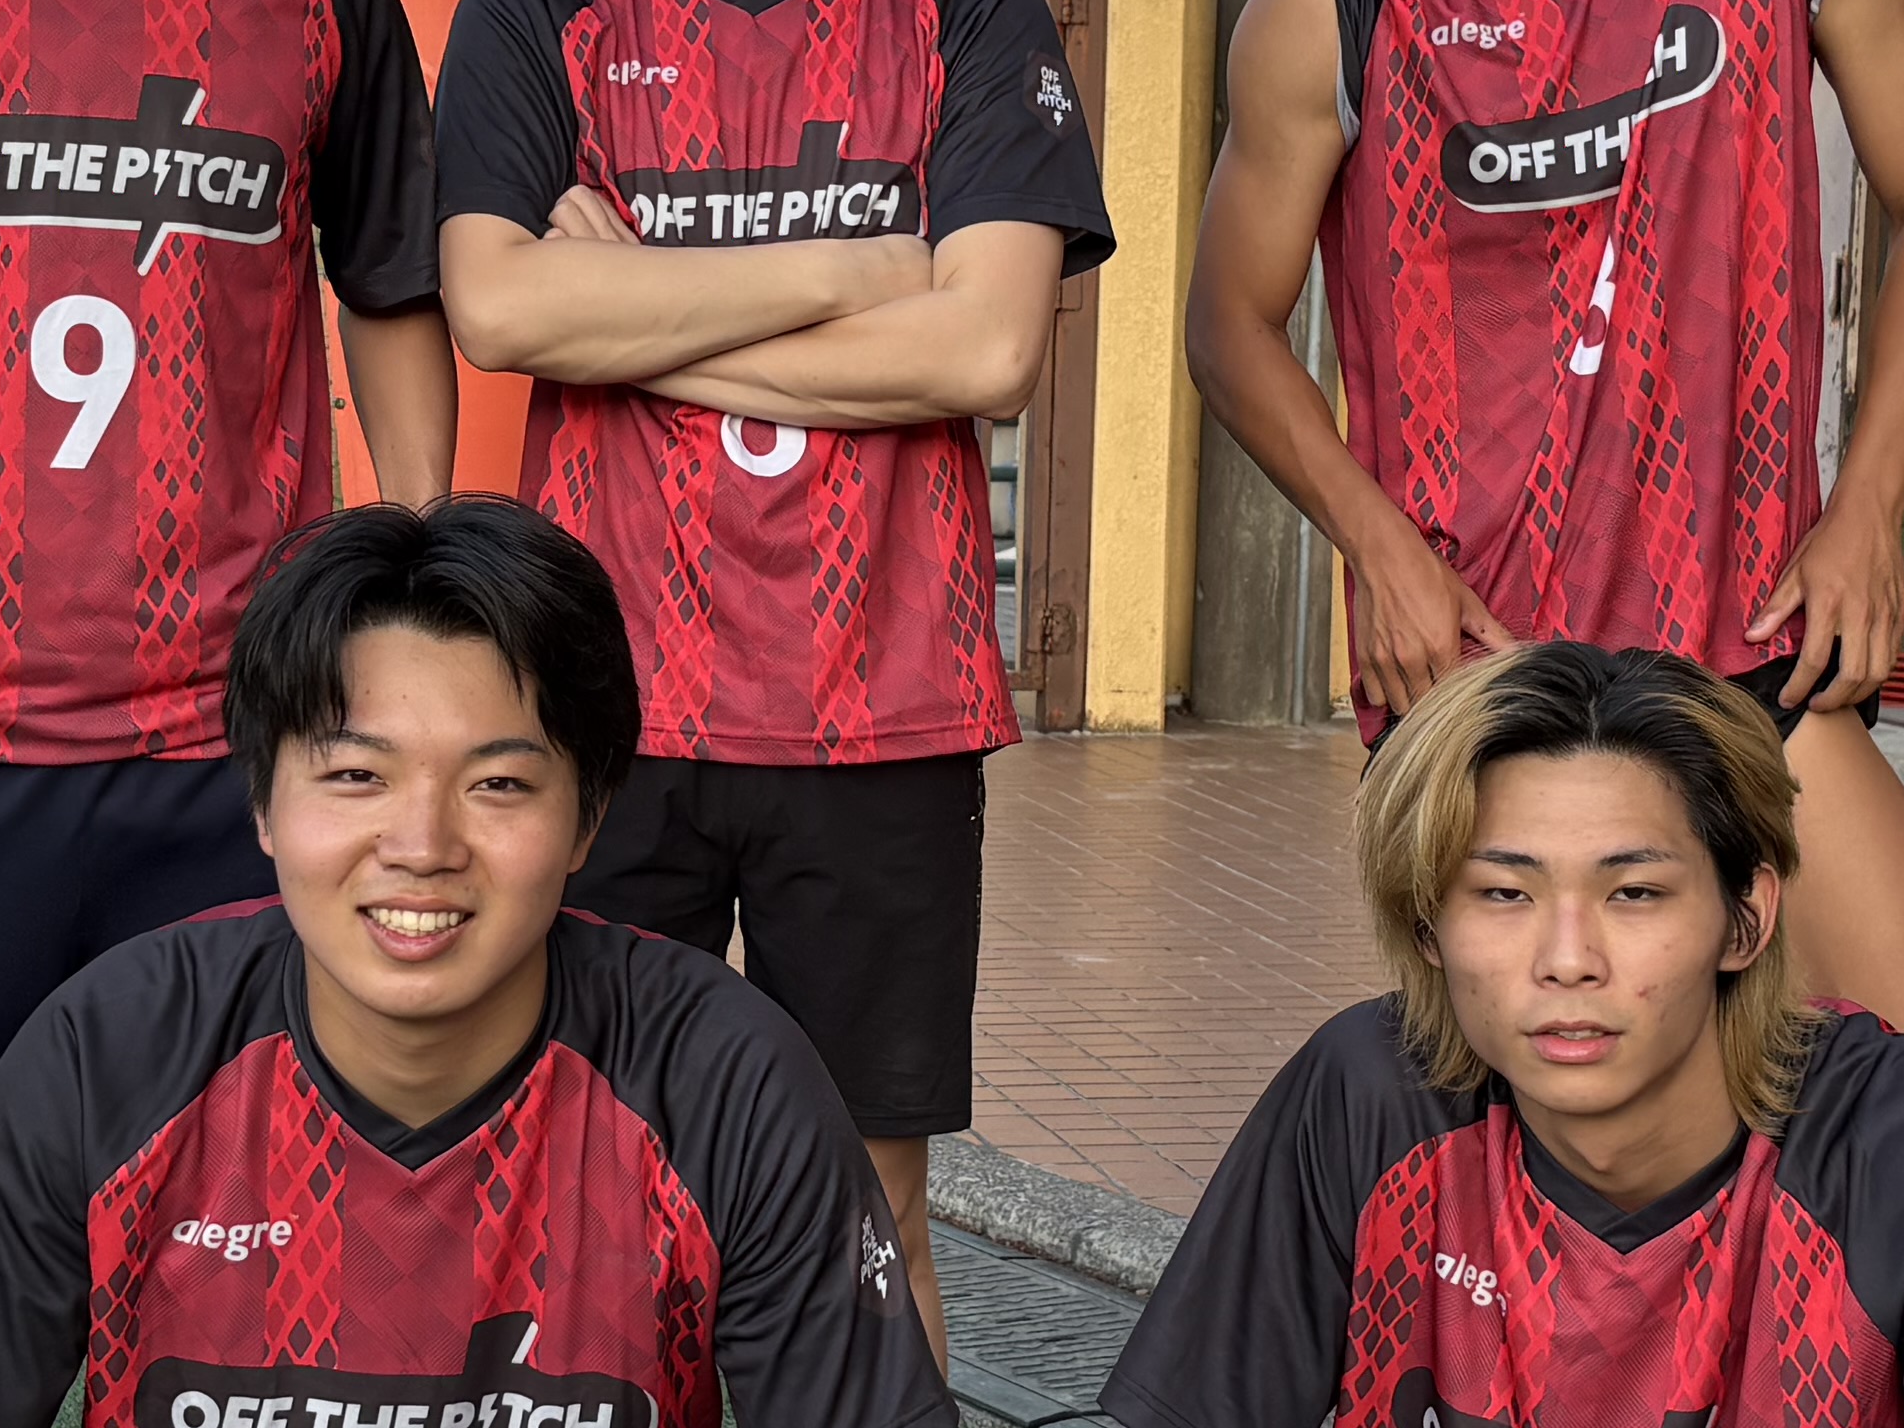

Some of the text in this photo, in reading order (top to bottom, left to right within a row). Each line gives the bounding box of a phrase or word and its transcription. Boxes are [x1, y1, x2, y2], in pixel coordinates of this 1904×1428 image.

[1431, 17, 1526, 50] alegre
[607, 59, 679, 86] alere
[1041, 80, 1063, 98] THE
[1037, 91, 1073, 112] PITCH
[1468, 114, 1640, 184] OFF TH
[0, 142, 108, 193] THE
[112, 146, 270, 210] PITCH
[705, 191, 774, 240] THE
[30, 294, 137, 469] 9
[172, 1214, 293, 1262] alegre
[1434, 1252, 1510, 1317] aleg
